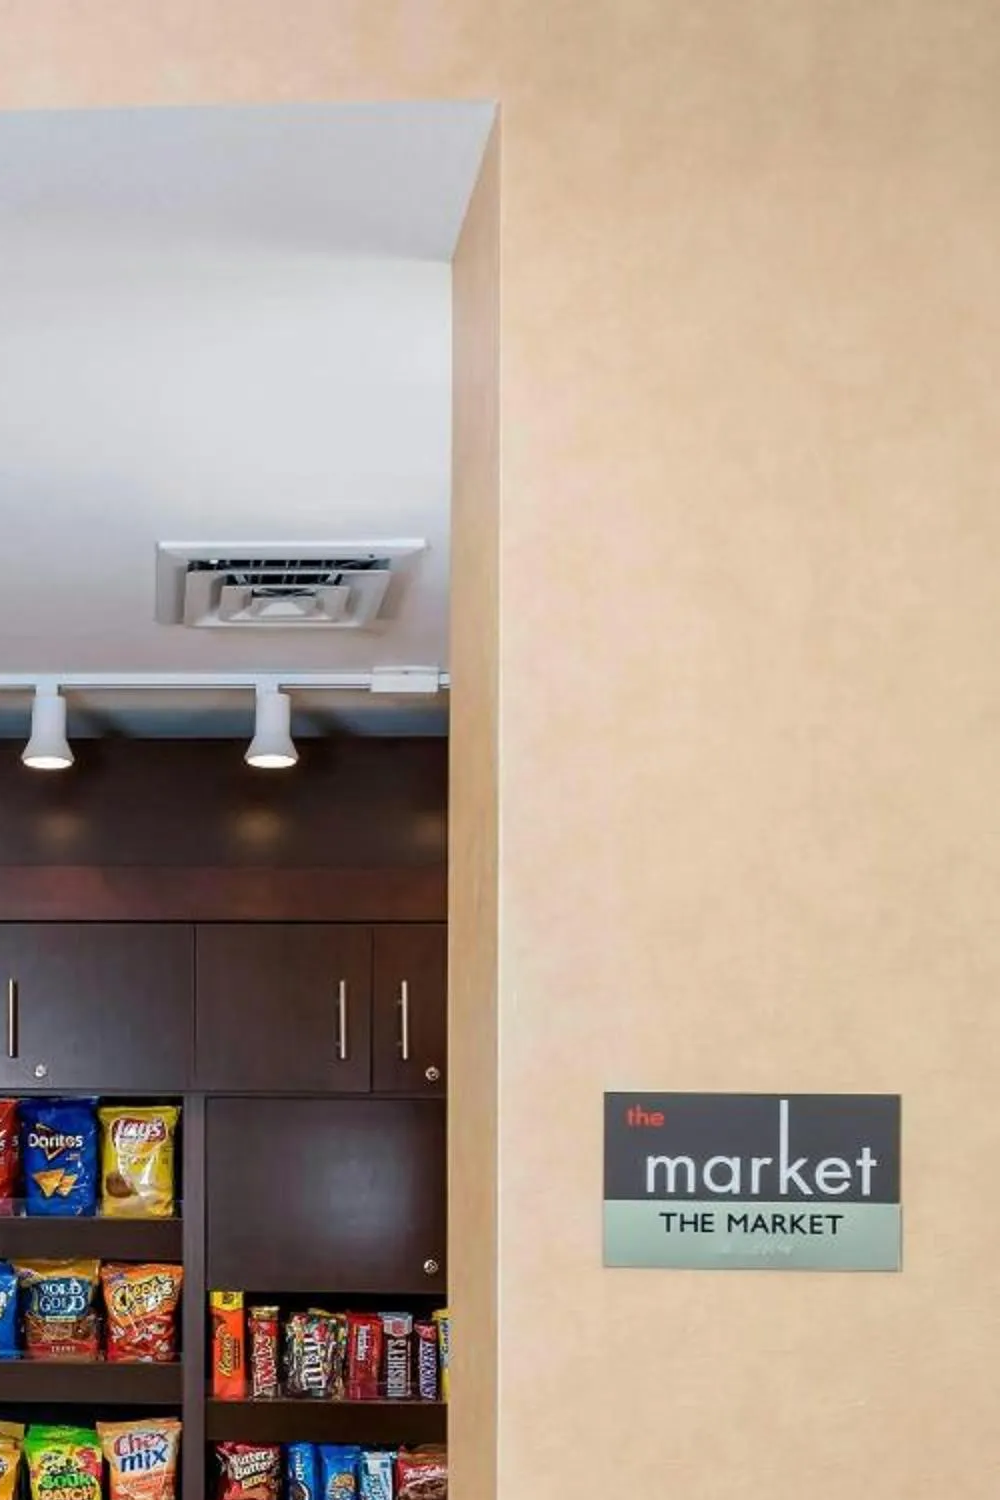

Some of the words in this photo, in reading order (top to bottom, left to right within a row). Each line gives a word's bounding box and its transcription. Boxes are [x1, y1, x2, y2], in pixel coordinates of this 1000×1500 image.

[627, 1104, 665, 1127] the
[28, 1132, 84, 1148] Doritos
[645, 1100, 878, 1196] market
[659, 1212, 715, 1233] THE
[726, 1213, 845, 1236] MARKET
[39, 1295, 87, 1314] GOLD
[386, 1339, 407, 1397] HERSHEY'S
[113, 1430, 170, 1457] Chex
[120, 1444, 169, 1473] mix
